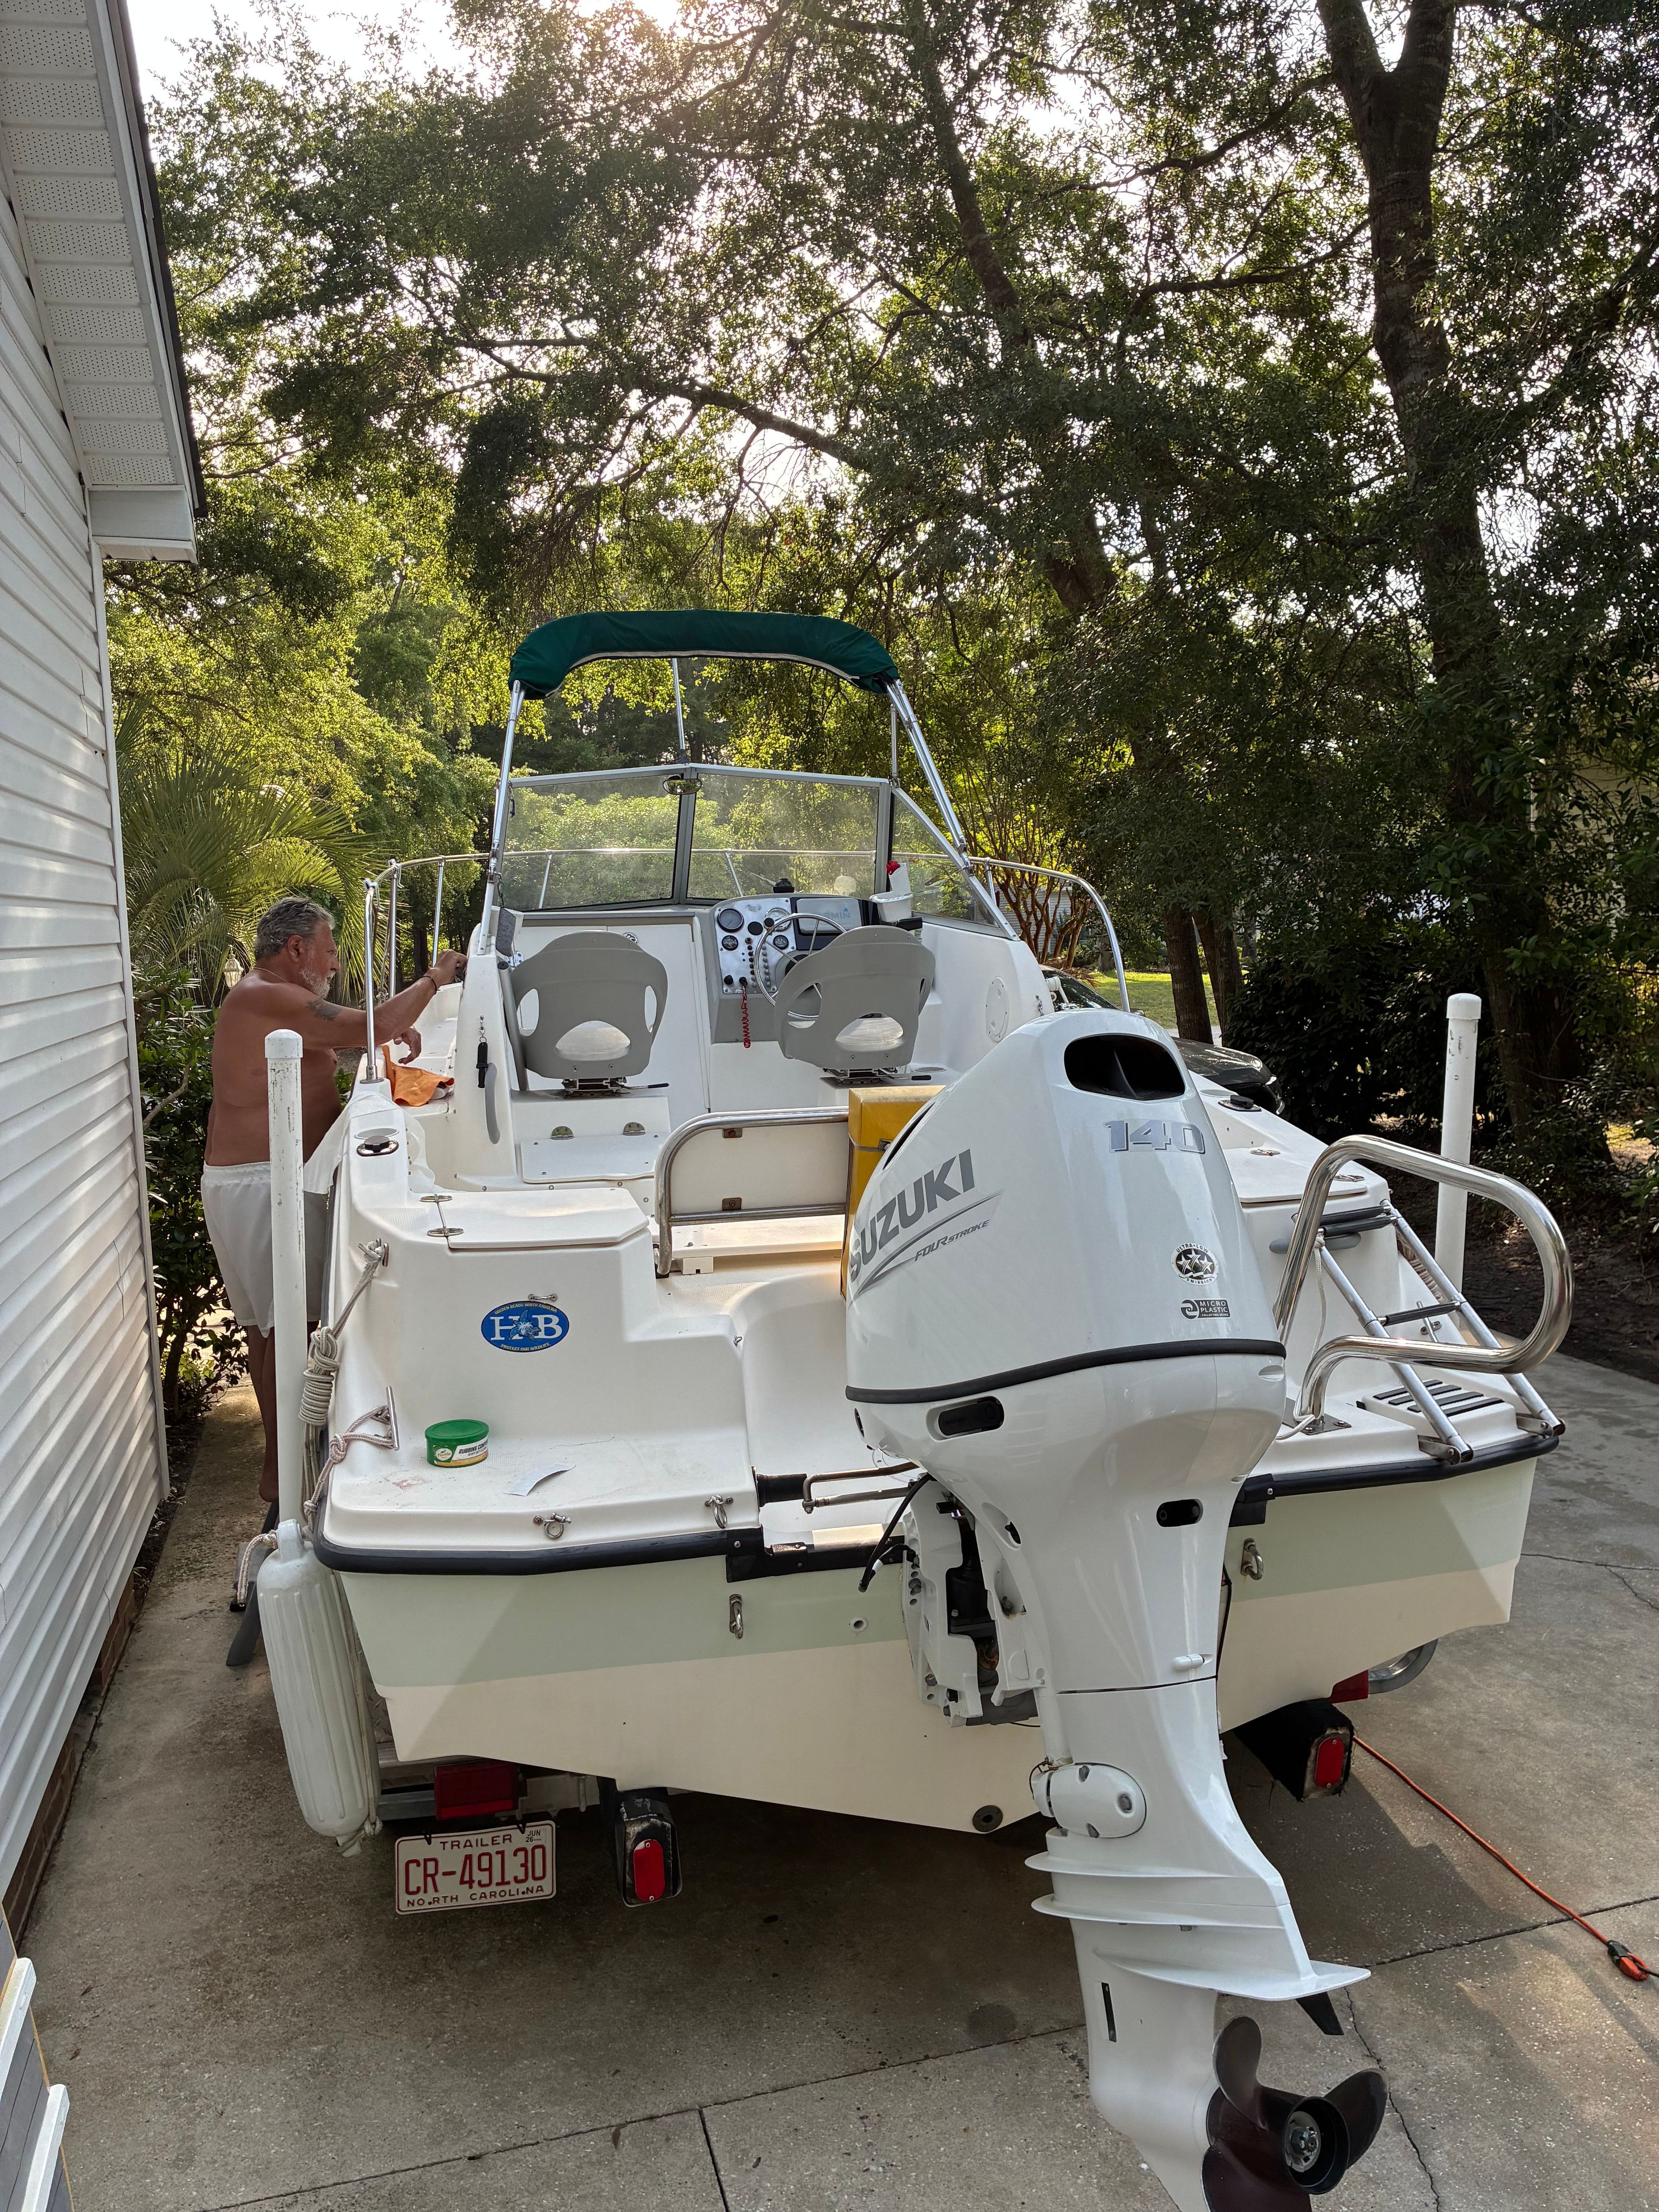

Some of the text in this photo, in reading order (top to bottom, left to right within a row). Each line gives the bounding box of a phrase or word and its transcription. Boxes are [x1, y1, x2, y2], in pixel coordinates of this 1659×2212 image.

[1104, 1120, 1205, 1154] 140
[850, 1148, 975, 1283] SUZUKI
[914, 1220, 990, 1262] FOUR STROKE
[459, 1446, 477, 1454] RUBBING
[440, 1834, 512, 1850] TRAILER
[405, 1844, 547, 1895] CR-49130
[407, 1885, 544, 1907] NORTH CAROLINA
